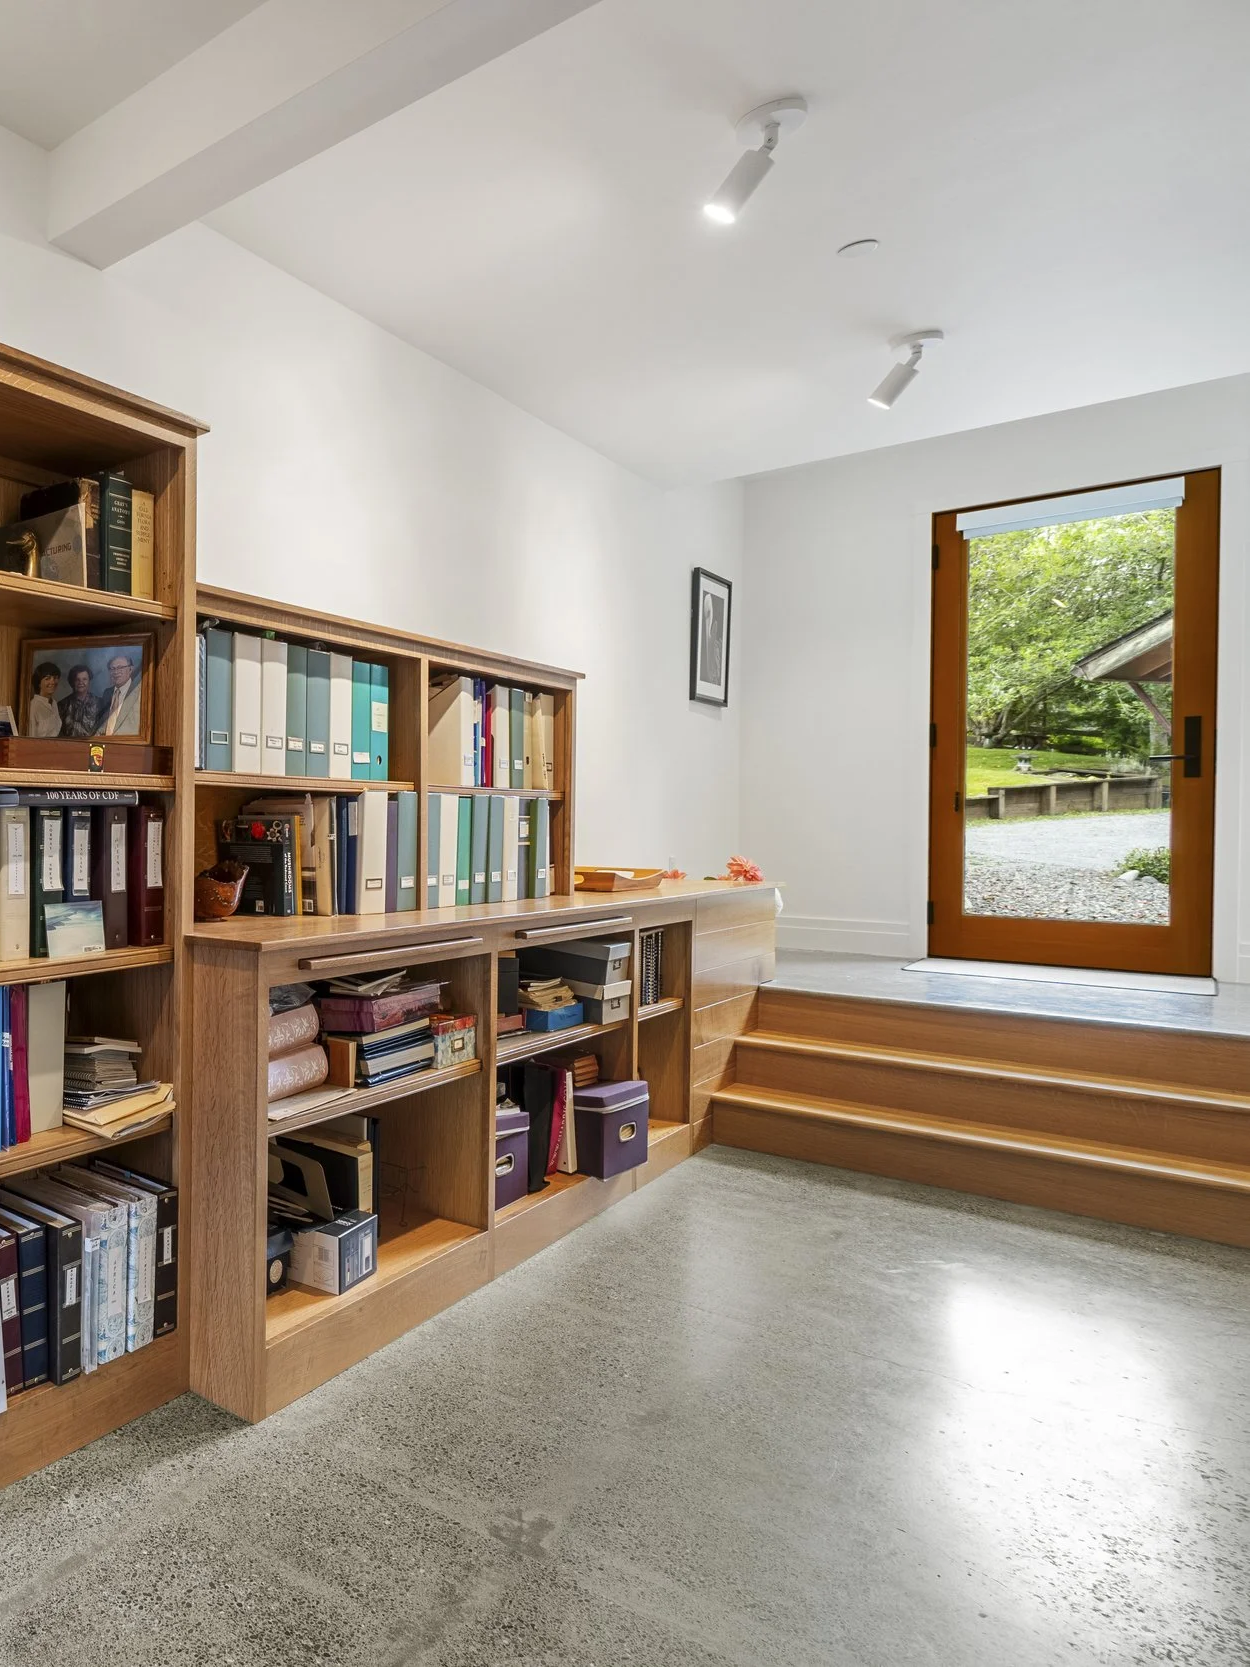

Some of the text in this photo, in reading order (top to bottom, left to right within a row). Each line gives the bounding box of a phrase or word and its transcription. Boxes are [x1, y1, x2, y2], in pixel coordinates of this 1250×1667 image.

[46, 791, 119, 799] 100 YEARS OF CDF
